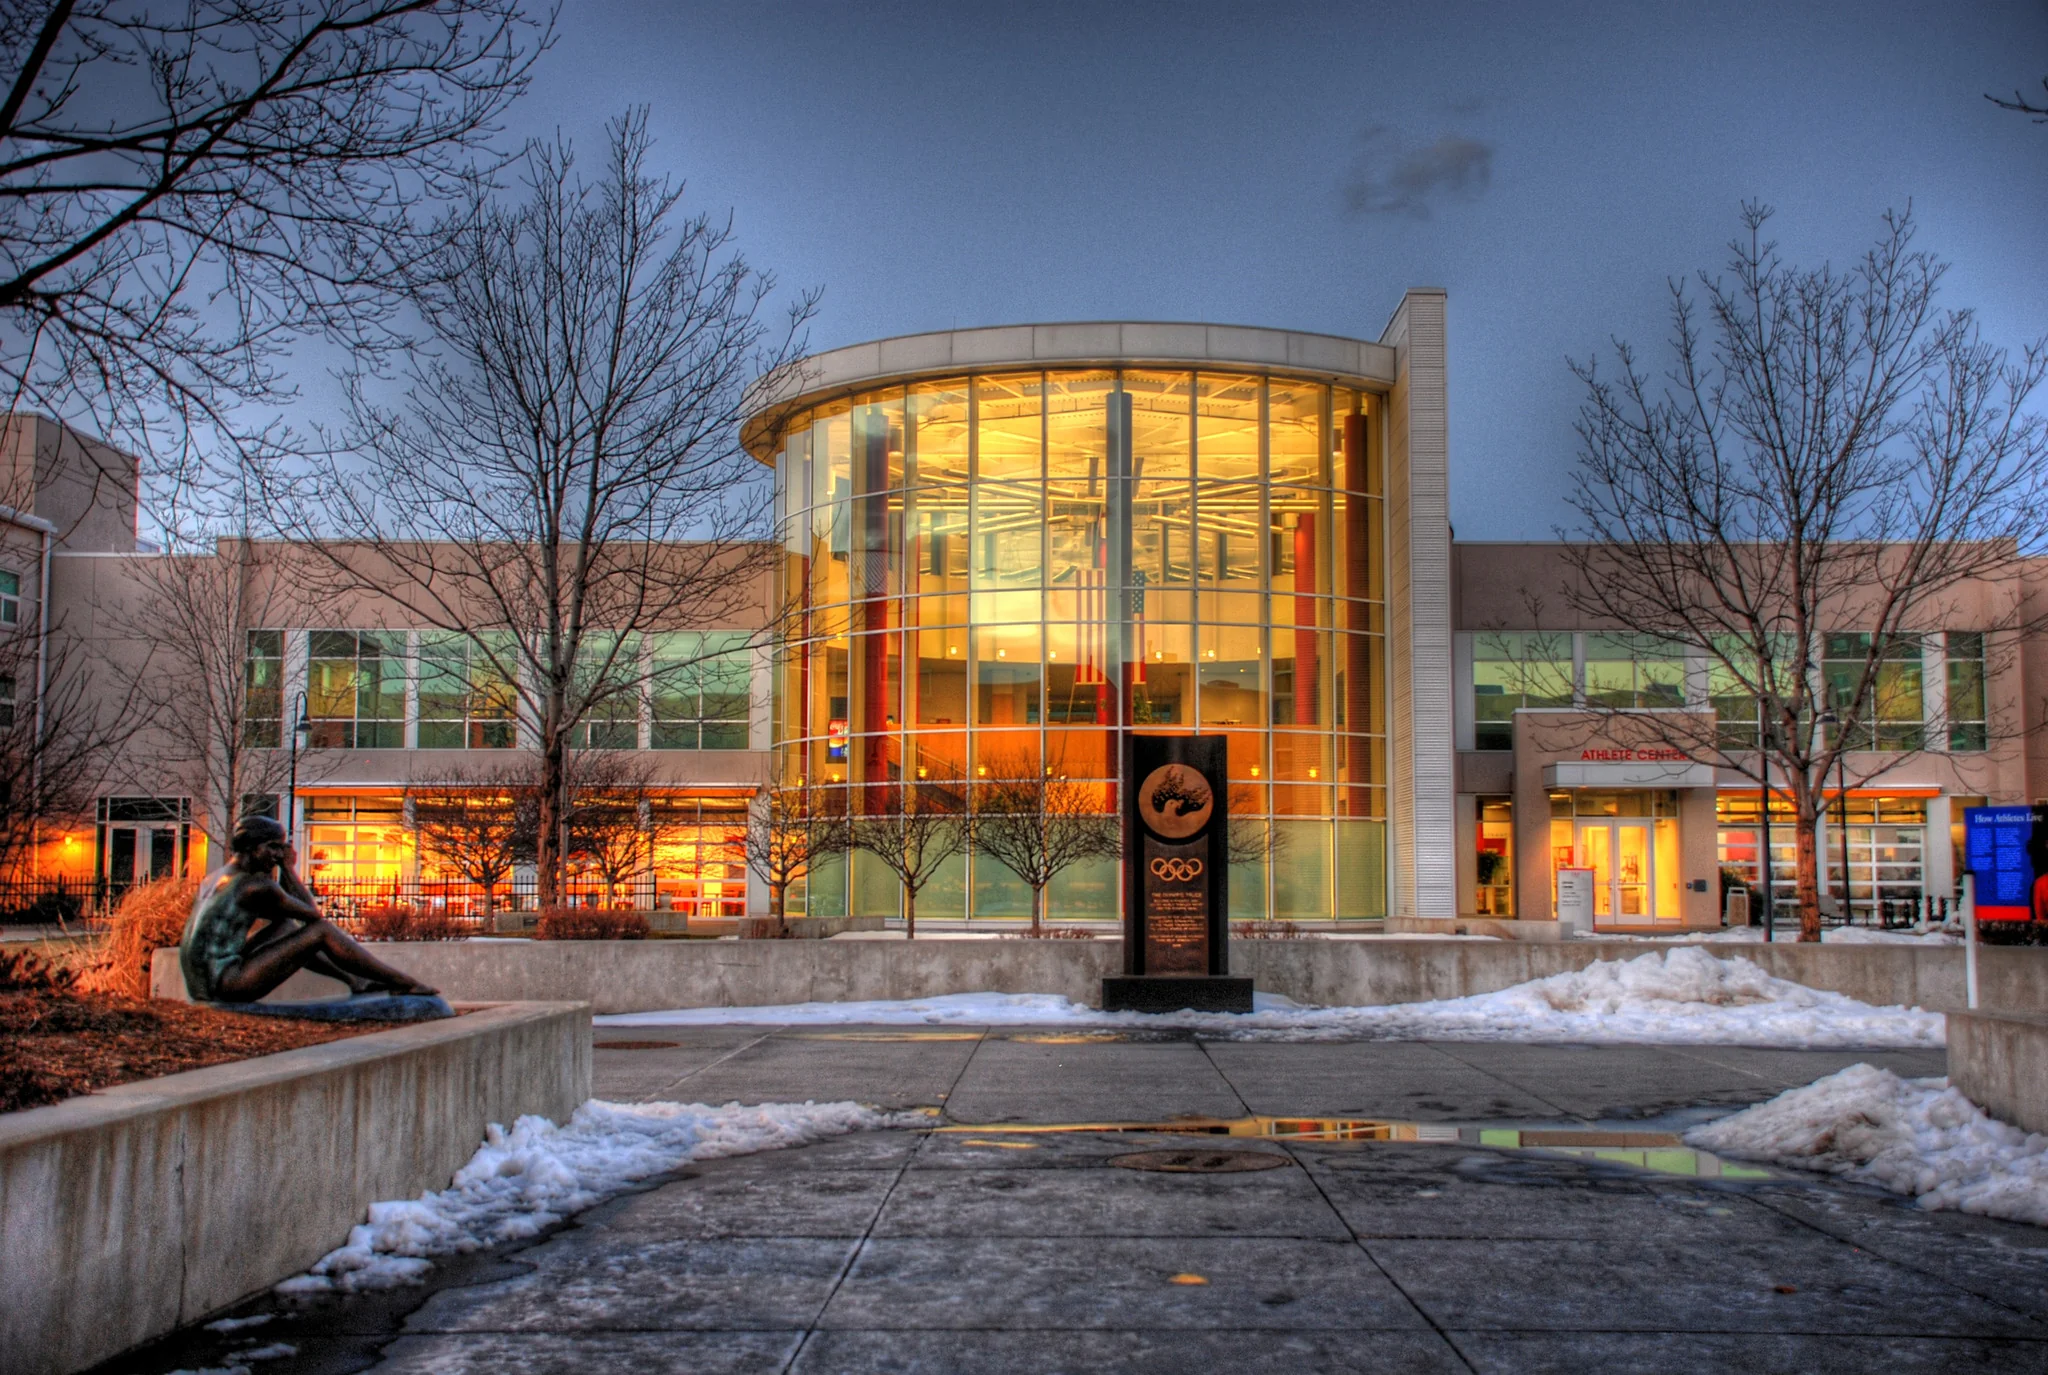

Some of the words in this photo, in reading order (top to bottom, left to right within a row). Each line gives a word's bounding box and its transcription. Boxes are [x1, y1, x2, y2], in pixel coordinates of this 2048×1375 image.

[1581, 749, 1632, 760] ATHLETE
[1974, 814, 1993, 823] How
[1994, 813, 2024, 823] Athletes
[2026, 813, 2044, 822] Live
